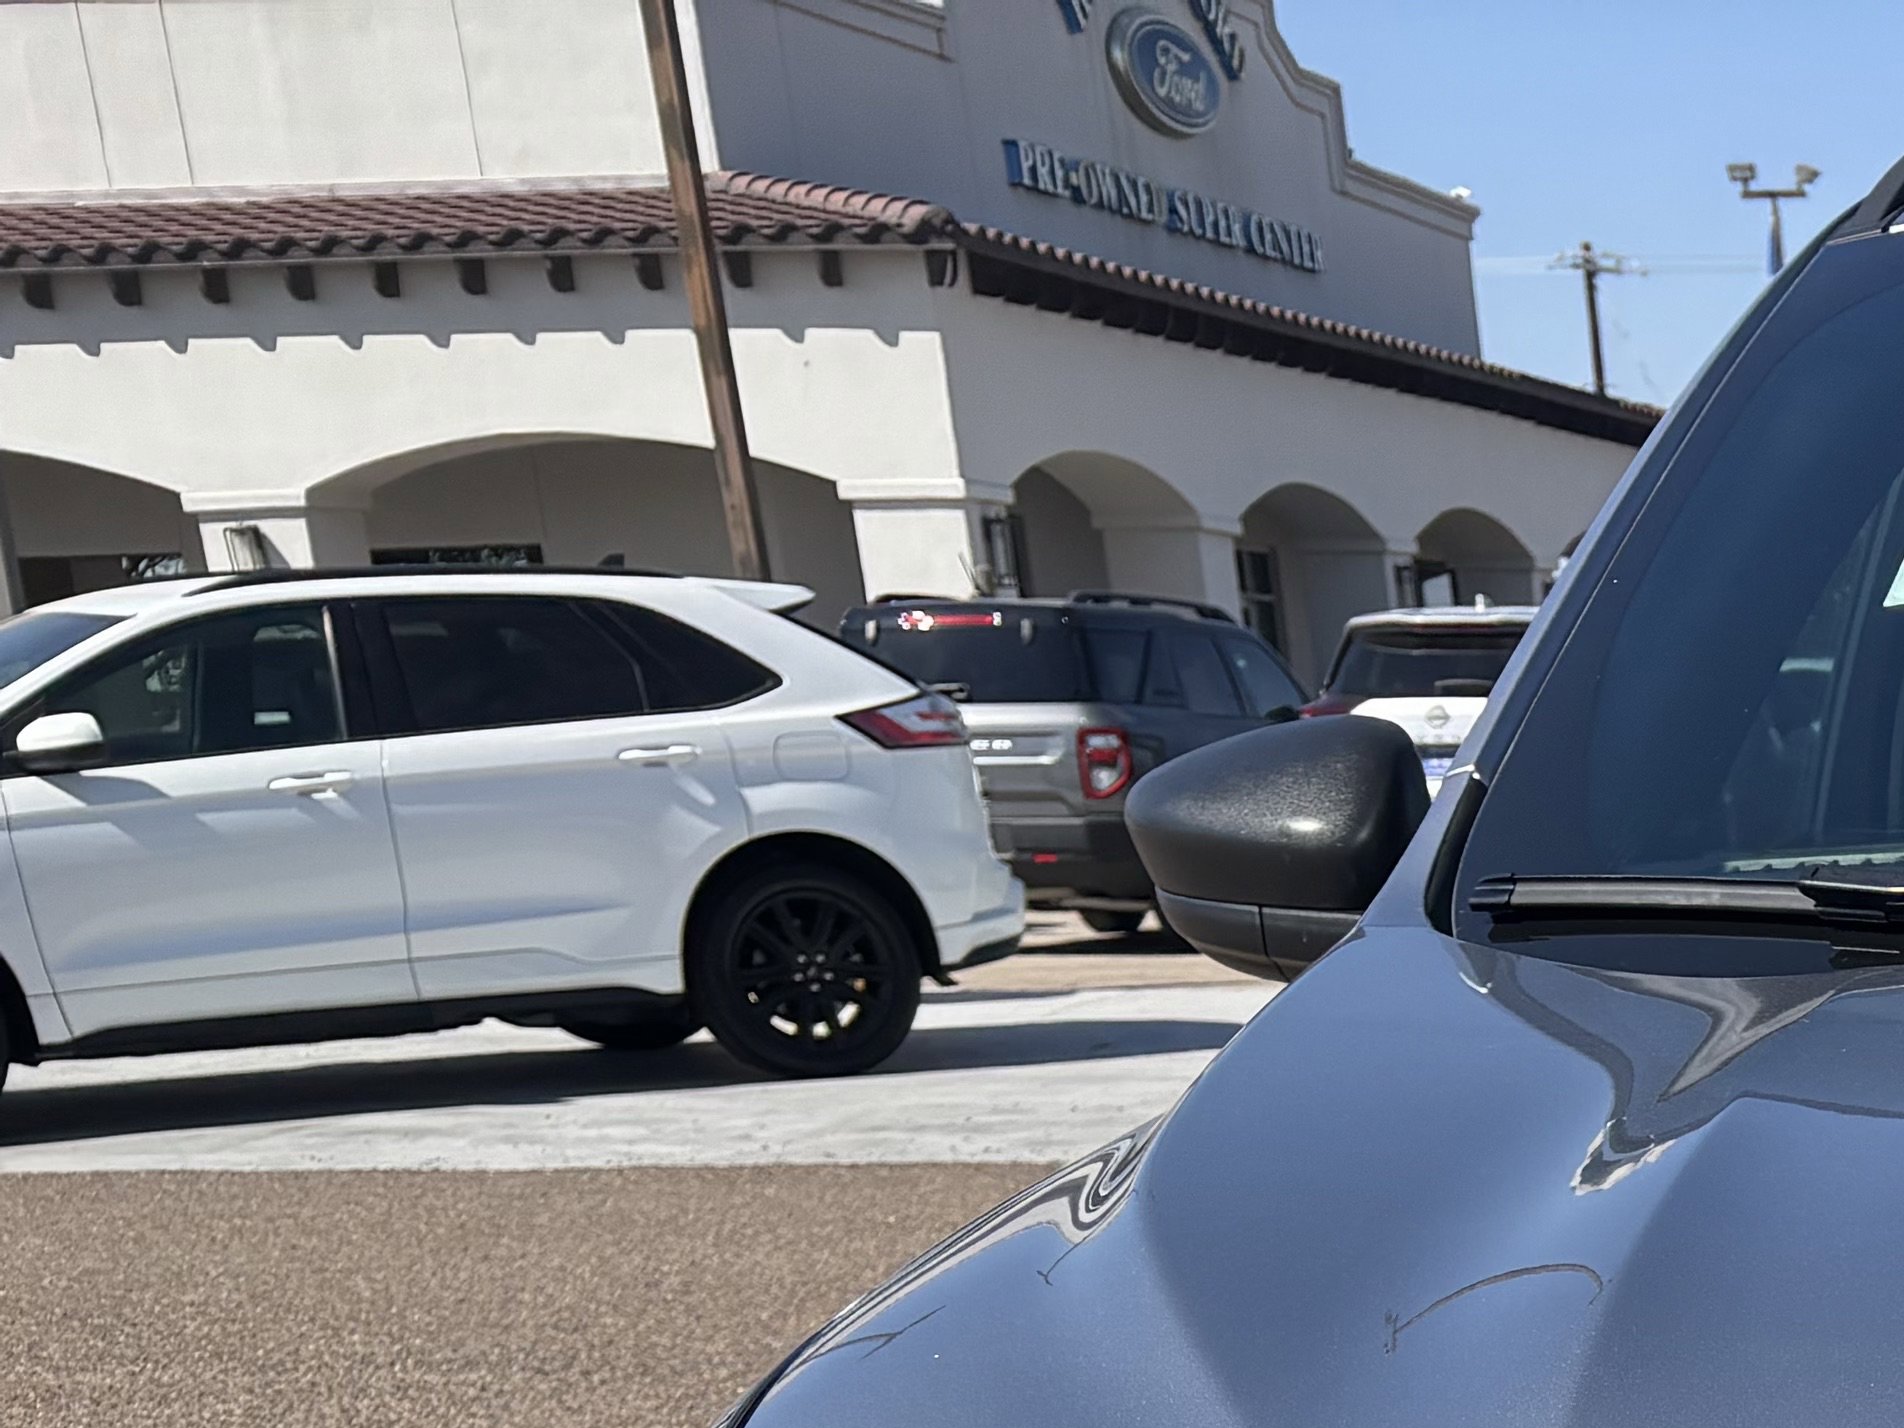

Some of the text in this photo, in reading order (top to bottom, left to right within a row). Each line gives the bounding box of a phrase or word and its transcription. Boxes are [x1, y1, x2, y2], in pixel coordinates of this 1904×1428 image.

[1153, 39, 1208, 112] Ford
[1015, 139, 1324, 272] PRE-OWNED SUPER CENTER
